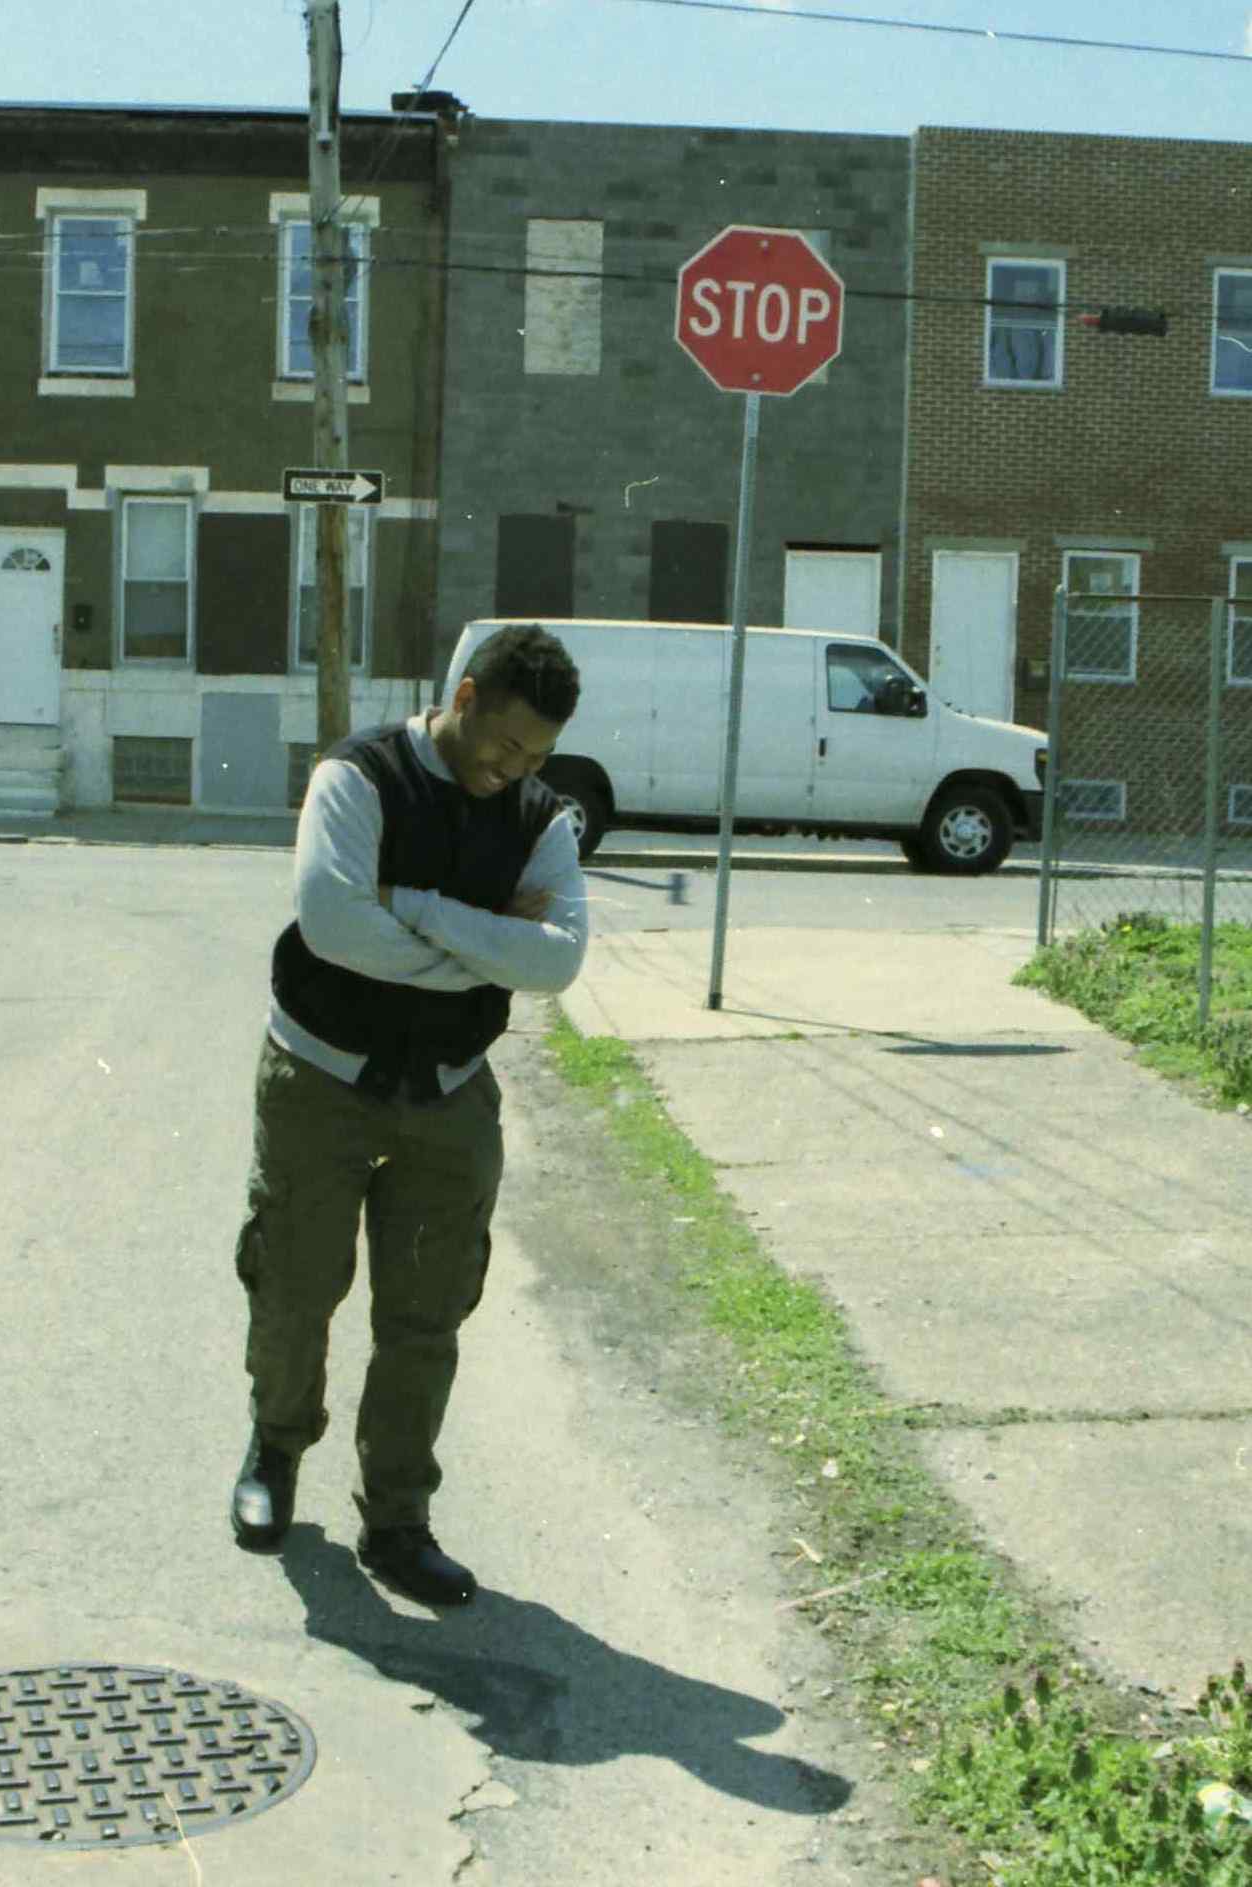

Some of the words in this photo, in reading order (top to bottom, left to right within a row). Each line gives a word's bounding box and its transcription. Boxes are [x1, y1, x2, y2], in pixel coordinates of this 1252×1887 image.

[689, 278, 831, 345] STOP
[293, 479, 319, 493] ONE
[325, 480, 353, 494] WAY
